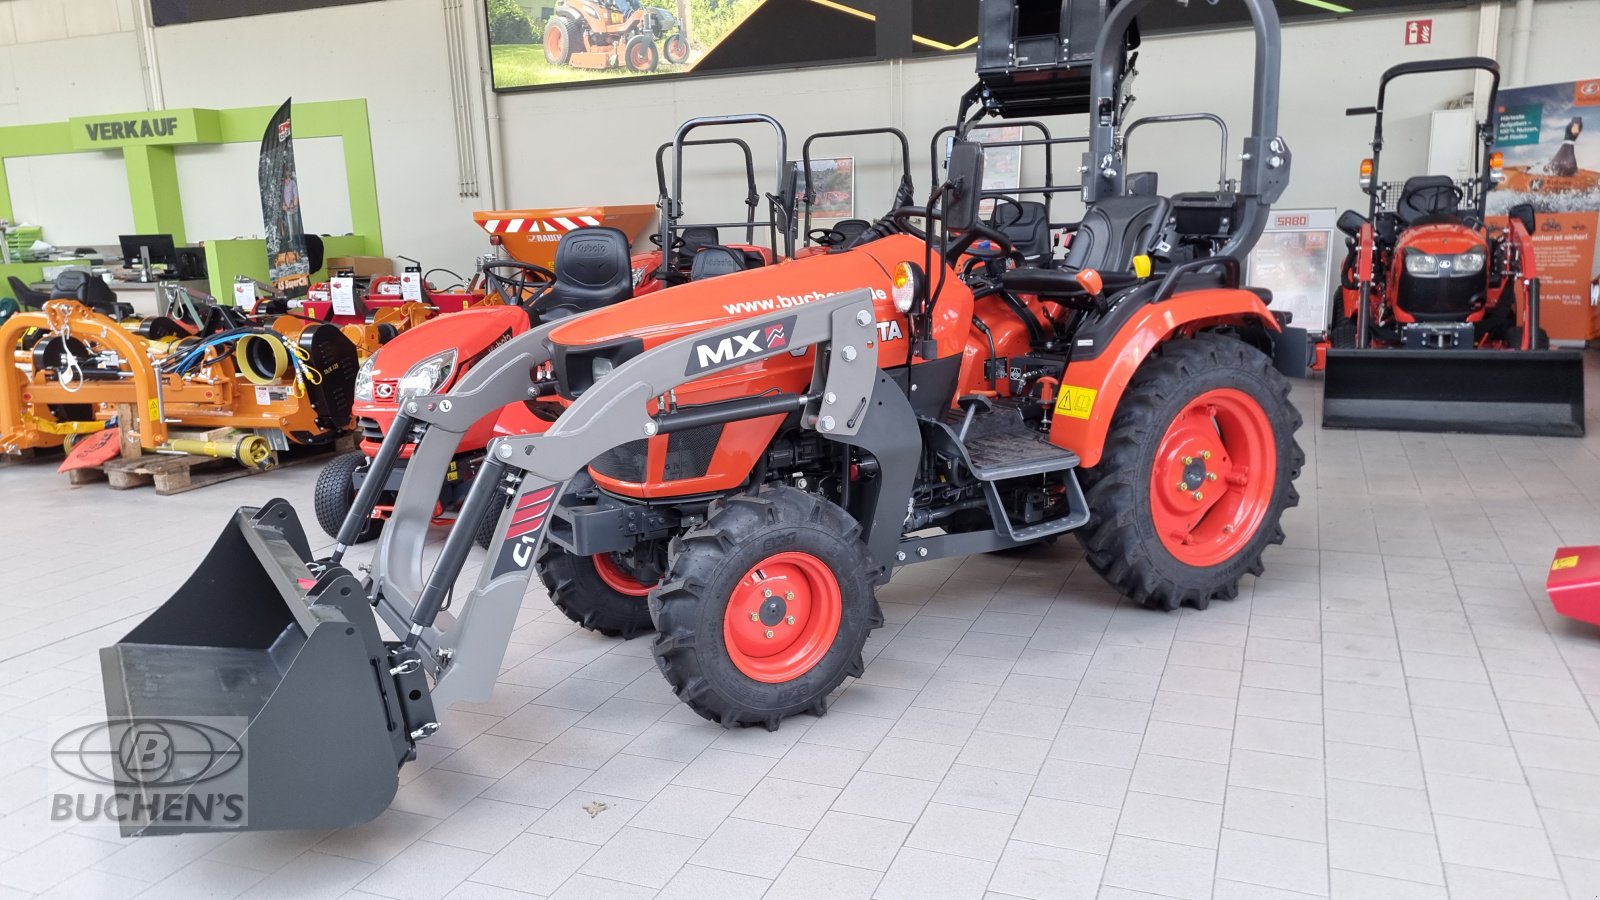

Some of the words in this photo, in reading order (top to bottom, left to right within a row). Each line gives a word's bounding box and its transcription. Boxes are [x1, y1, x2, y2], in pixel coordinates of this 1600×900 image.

[85, 117, 177, 141] VERKAUF
[1277, 216, 1307, 226] SABO
[575, 243, 607, 254] Kubota
[697, 329, 763, 368] MX
[513, 535, 536, 568] C1
